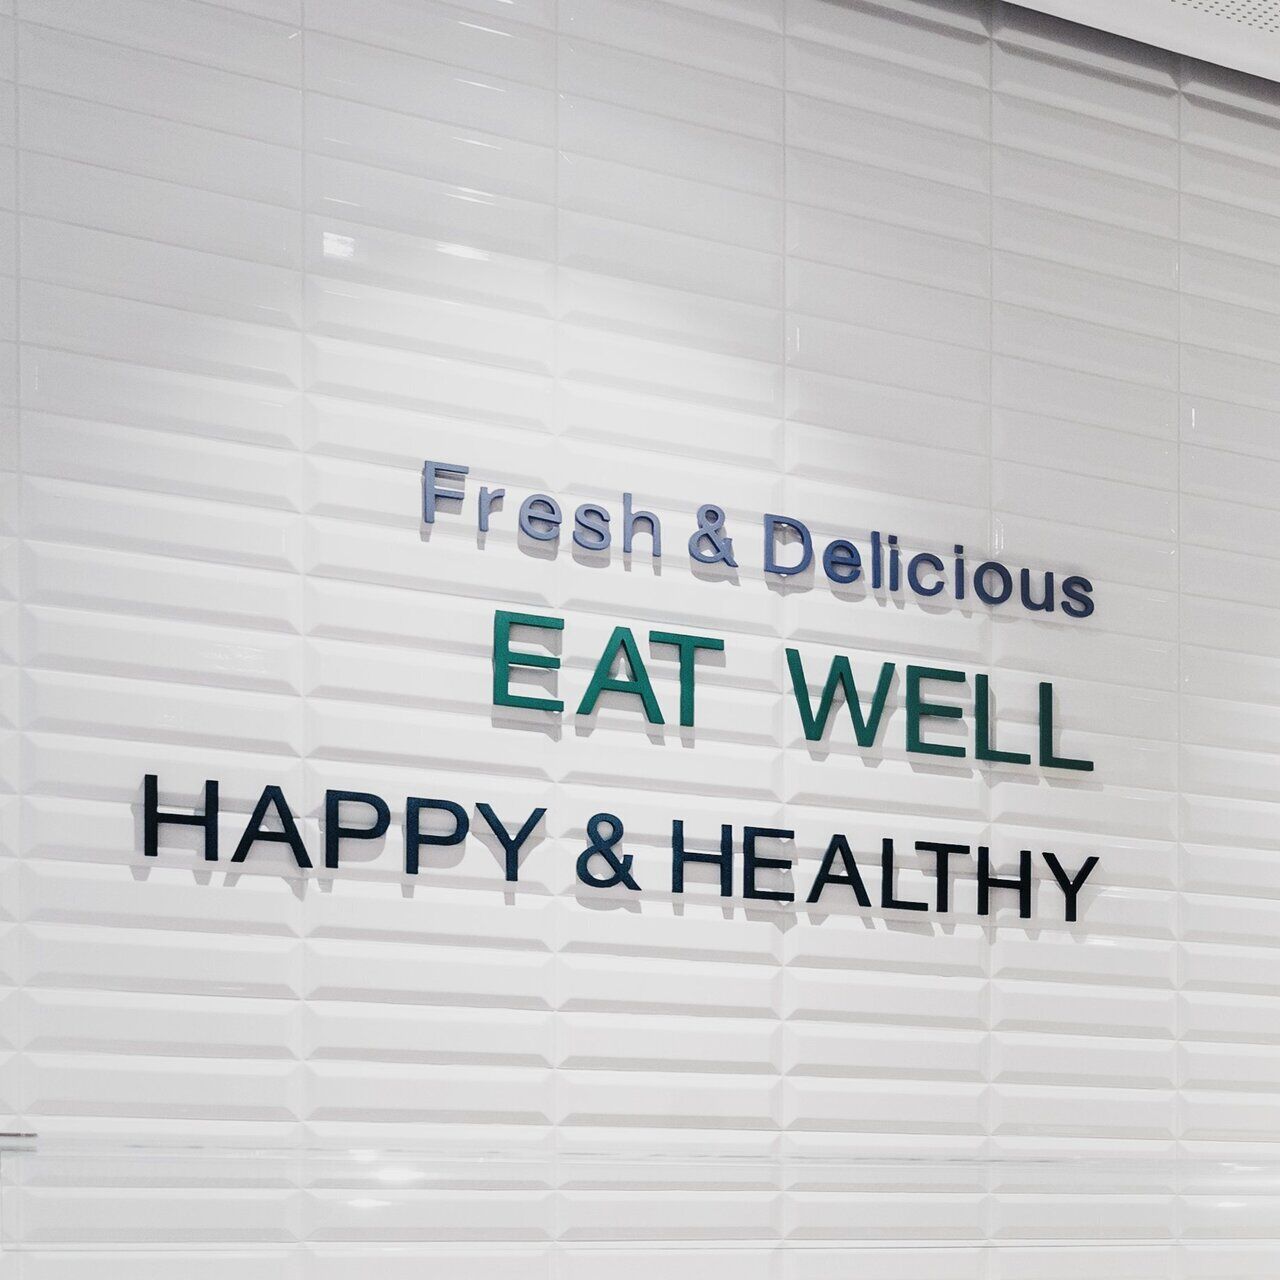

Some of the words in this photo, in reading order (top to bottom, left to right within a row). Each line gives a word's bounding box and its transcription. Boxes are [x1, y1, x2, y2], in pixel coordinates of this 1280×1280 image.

[421, 459, 662, 558] Fresh
[688, 504, 738, 569] &
[763, 513, 1095, 619] Delicious
[492, 610, 725, 728] EAT
[786, 648, 1095, 772] WELL
[142, 774, 548, 883] HAPPY
[576, 812, 641, 892] &
[671, 819, 1100, 923] HEALTHY
